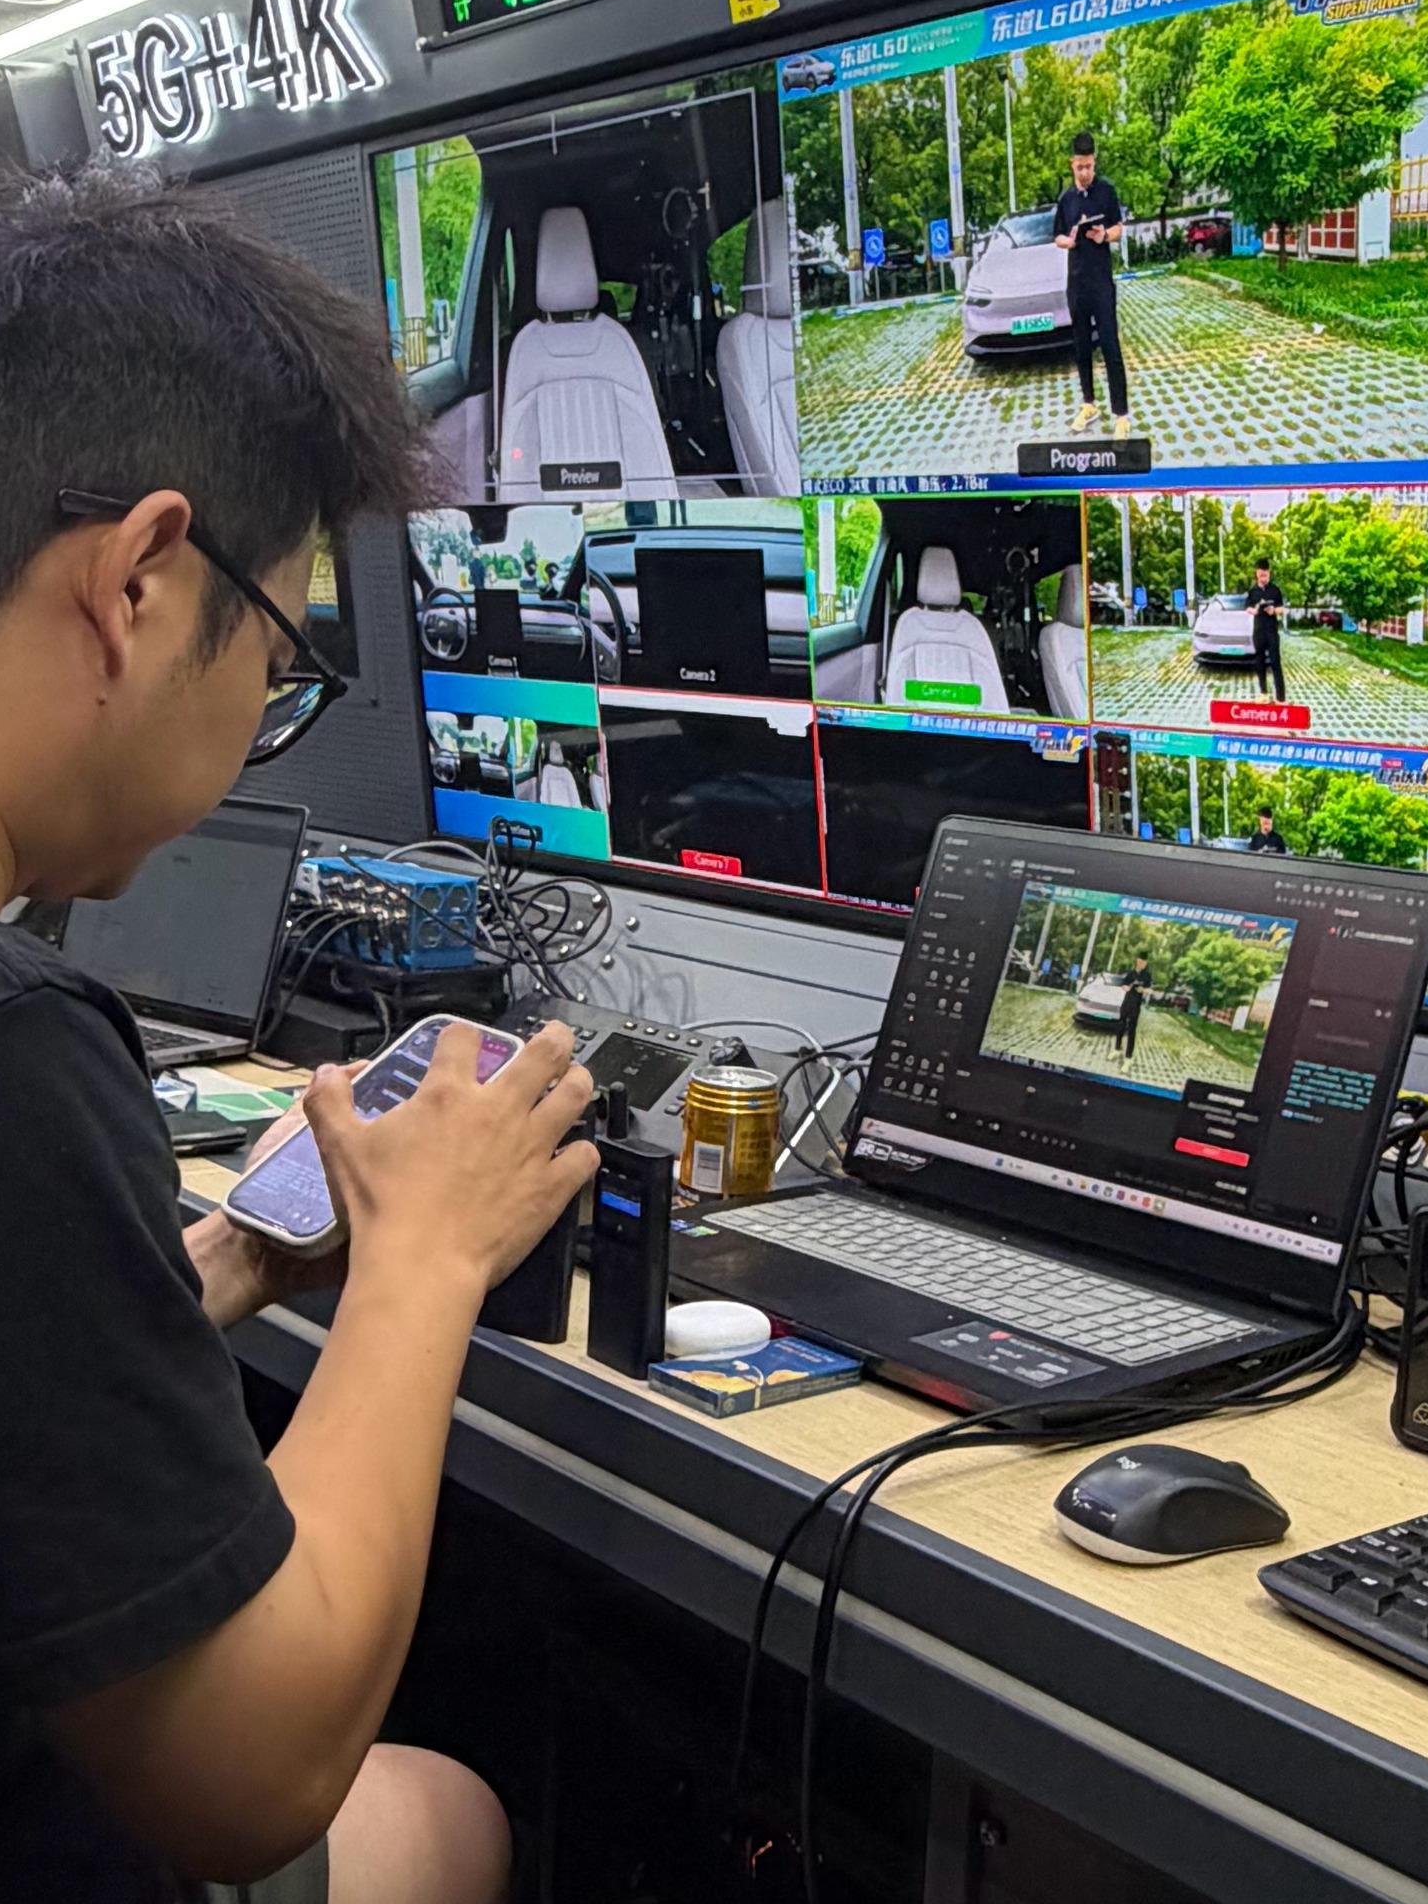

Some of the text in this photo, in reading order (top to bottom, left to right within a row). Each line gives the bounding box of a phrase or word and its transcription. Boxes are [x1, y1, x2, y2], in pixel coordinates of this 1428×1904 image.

[1050, 448, 1117, 472] Program
[560, 468, 600, 485] Preview
[679, 667, 708, 683] Camera
[1230, 705, 1290, 723] Camera 4
